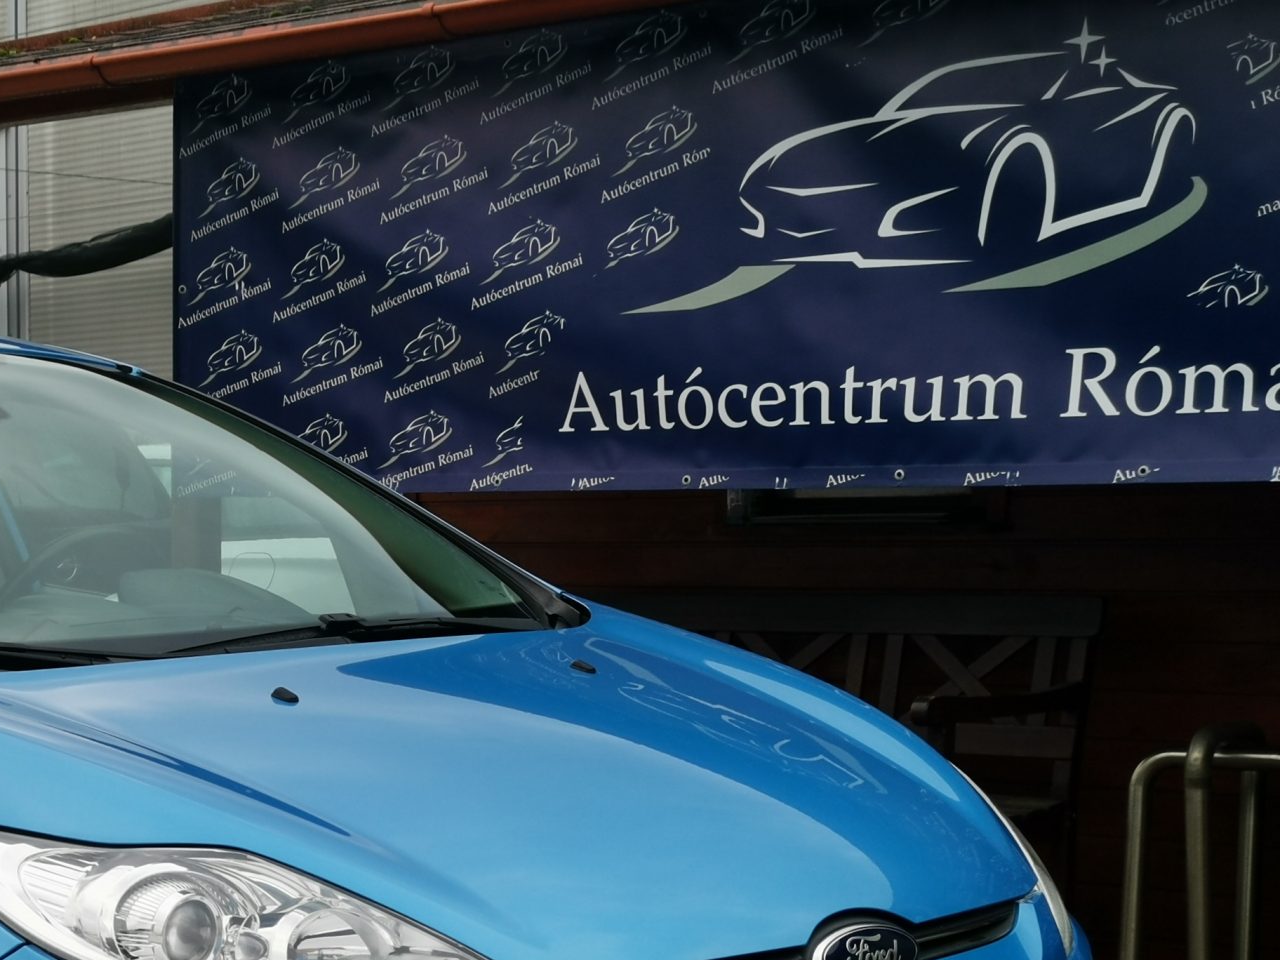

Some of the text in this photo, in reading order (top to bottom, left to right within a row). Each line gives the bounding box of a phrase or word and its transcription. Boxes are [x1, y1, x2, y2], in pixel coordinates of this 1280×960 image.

[479, 84, 553, 125] Autócentrum
[591, 68, 670, 110] Autócentrum
[272, 110, 335, 149] Autócentrum
[370, 98, 442, 138] Autócentrum
[281, 178, 380, 234] Autócentrum Római
[380, 166, 489, 225] Autócentrum Római
[488, 153, 601, 215] Autócentrum Római
[600, 161, 679, 204] Autócentrum
[190, 187, 280, 243] Autócentrum Római
[272, 270, 367, 323] Autócentrum Római
[370, 261, 471, 317] Autócentrum Római
[471, 252, 583, 311] Autócentrum Római
[177, 294, 239, 329] Autócentrum
[250, 362, 282, 384] Római
[282, 356, 384, 407] Autócentrum Római
[384, 351, 485, 403] Autócentrum Római
[558, 365, 1028, 433] Autócentrum
[438, 444, 474, 467] Római
